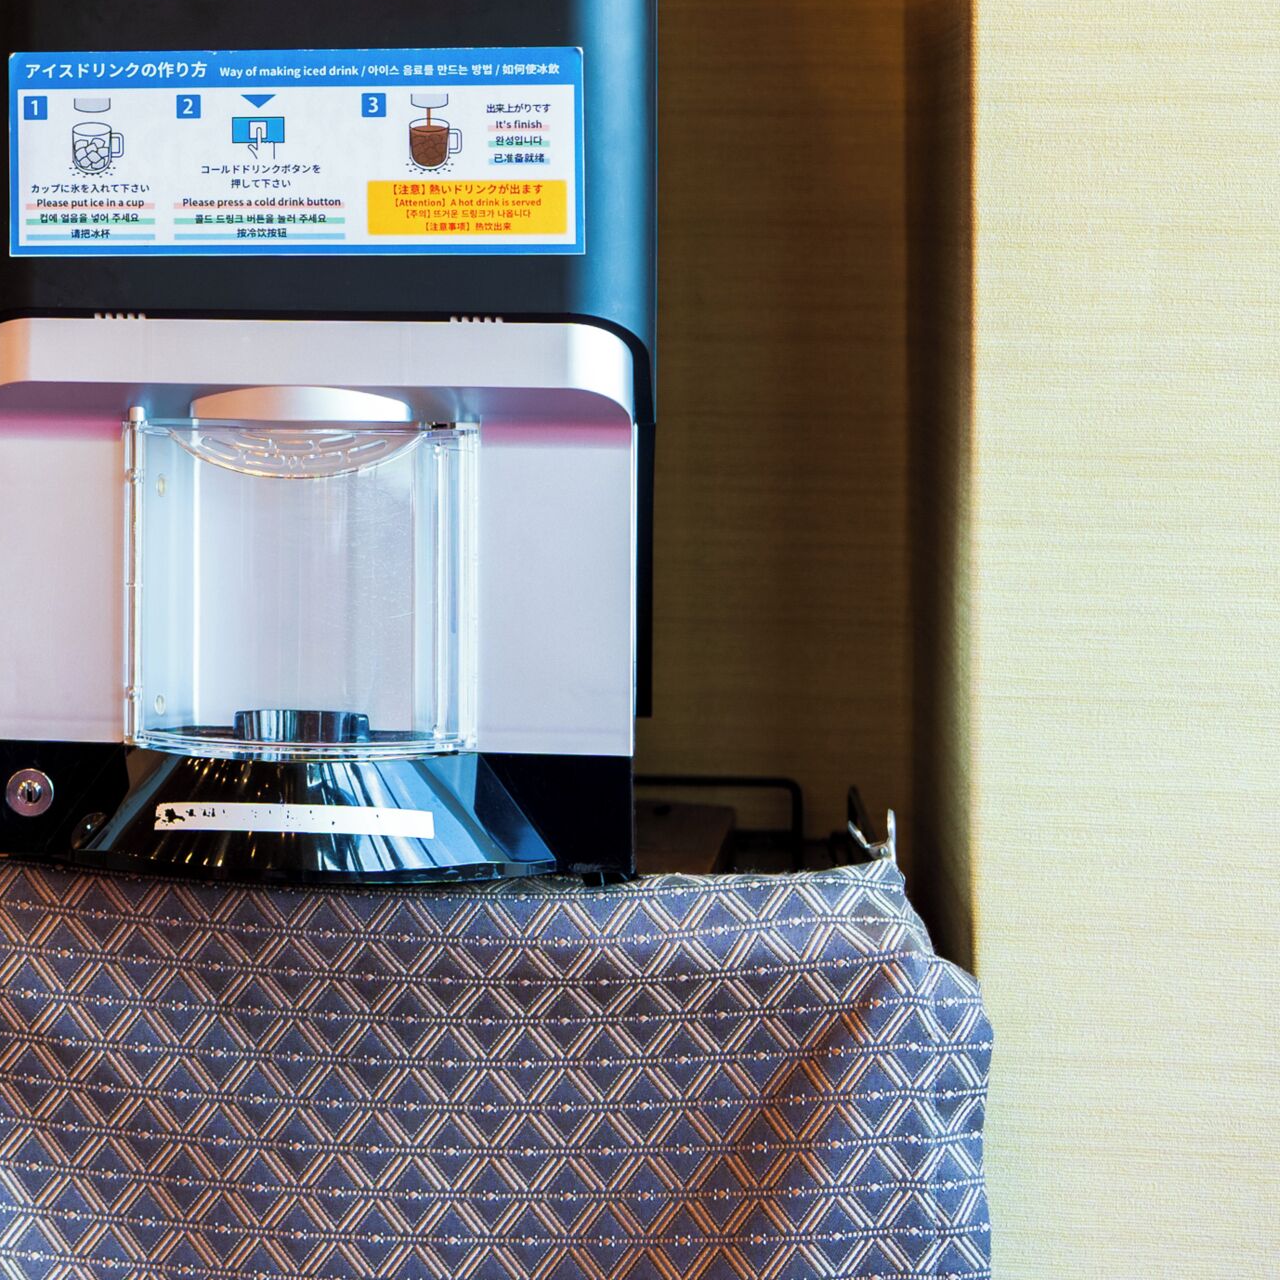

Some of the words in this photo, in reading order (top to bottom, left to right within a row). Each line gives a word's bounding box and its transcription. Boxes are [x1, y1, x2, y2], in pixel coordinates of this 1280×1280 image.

[25, 62, 208, 79] アイスドリンクの作り方
[220, 66, 243, 79] Way
[246, 66, 257, 76] of
[259, 65, 301, 78] making
[303, 65, 326, 76] iced
[329, 65, 358, 76] drink
[368, 64, 399, 76] 아이스
[403, 64, 433, 76] 음료를
[437, 64, 468, 76] 만드는
[471, 64, 492, 76] 방법
[31, 100, 39, 115] 1
[183, 99, 193, 114] 2
[368, 97, 378, 113] 3
[486, 103, 551, 113] 出来上がりです
[495, 121, 511, 129] It's
[513, 120, 542, 129] finish
[495, 136, 543, 146] 완성입니다
[201, 164, 321, 174] コールドドリンクボタンを
[31, 184, 150, 193] カップに氷を入れて下さい
[231, 179, 291, 188] 押して下さい
[36, 199, 69, 207] Please
[71, 199, 88, 209] put
[90, 198, 105, 207] ice
[107, 198, 116, 207] in
[126, 200, 145, 209] cup
[183, 198, 215, 207] Please
[217, 198, 245, 208] press
[255, 197, 275, 207] cold
[278, 197, 304, 207] drink
[307, 197, 341, 206] button
[458, 198, 473, 206] hot
[476, 198, 499, 206] drink
[502, 198, 509, 206] is
[511, 198, 541, 206] served
[40, 213, 58, 223] 컵에
[91, 213, 109, 223] 넣어
[112, 213, 140, 223] 주세요
[216, 214, 243, 223] 드링크
[247, 214, 274, 223] 버튼을
[299, 213, 327, 223] 주세요
[497, 209, 531, 218] 나옵니다
